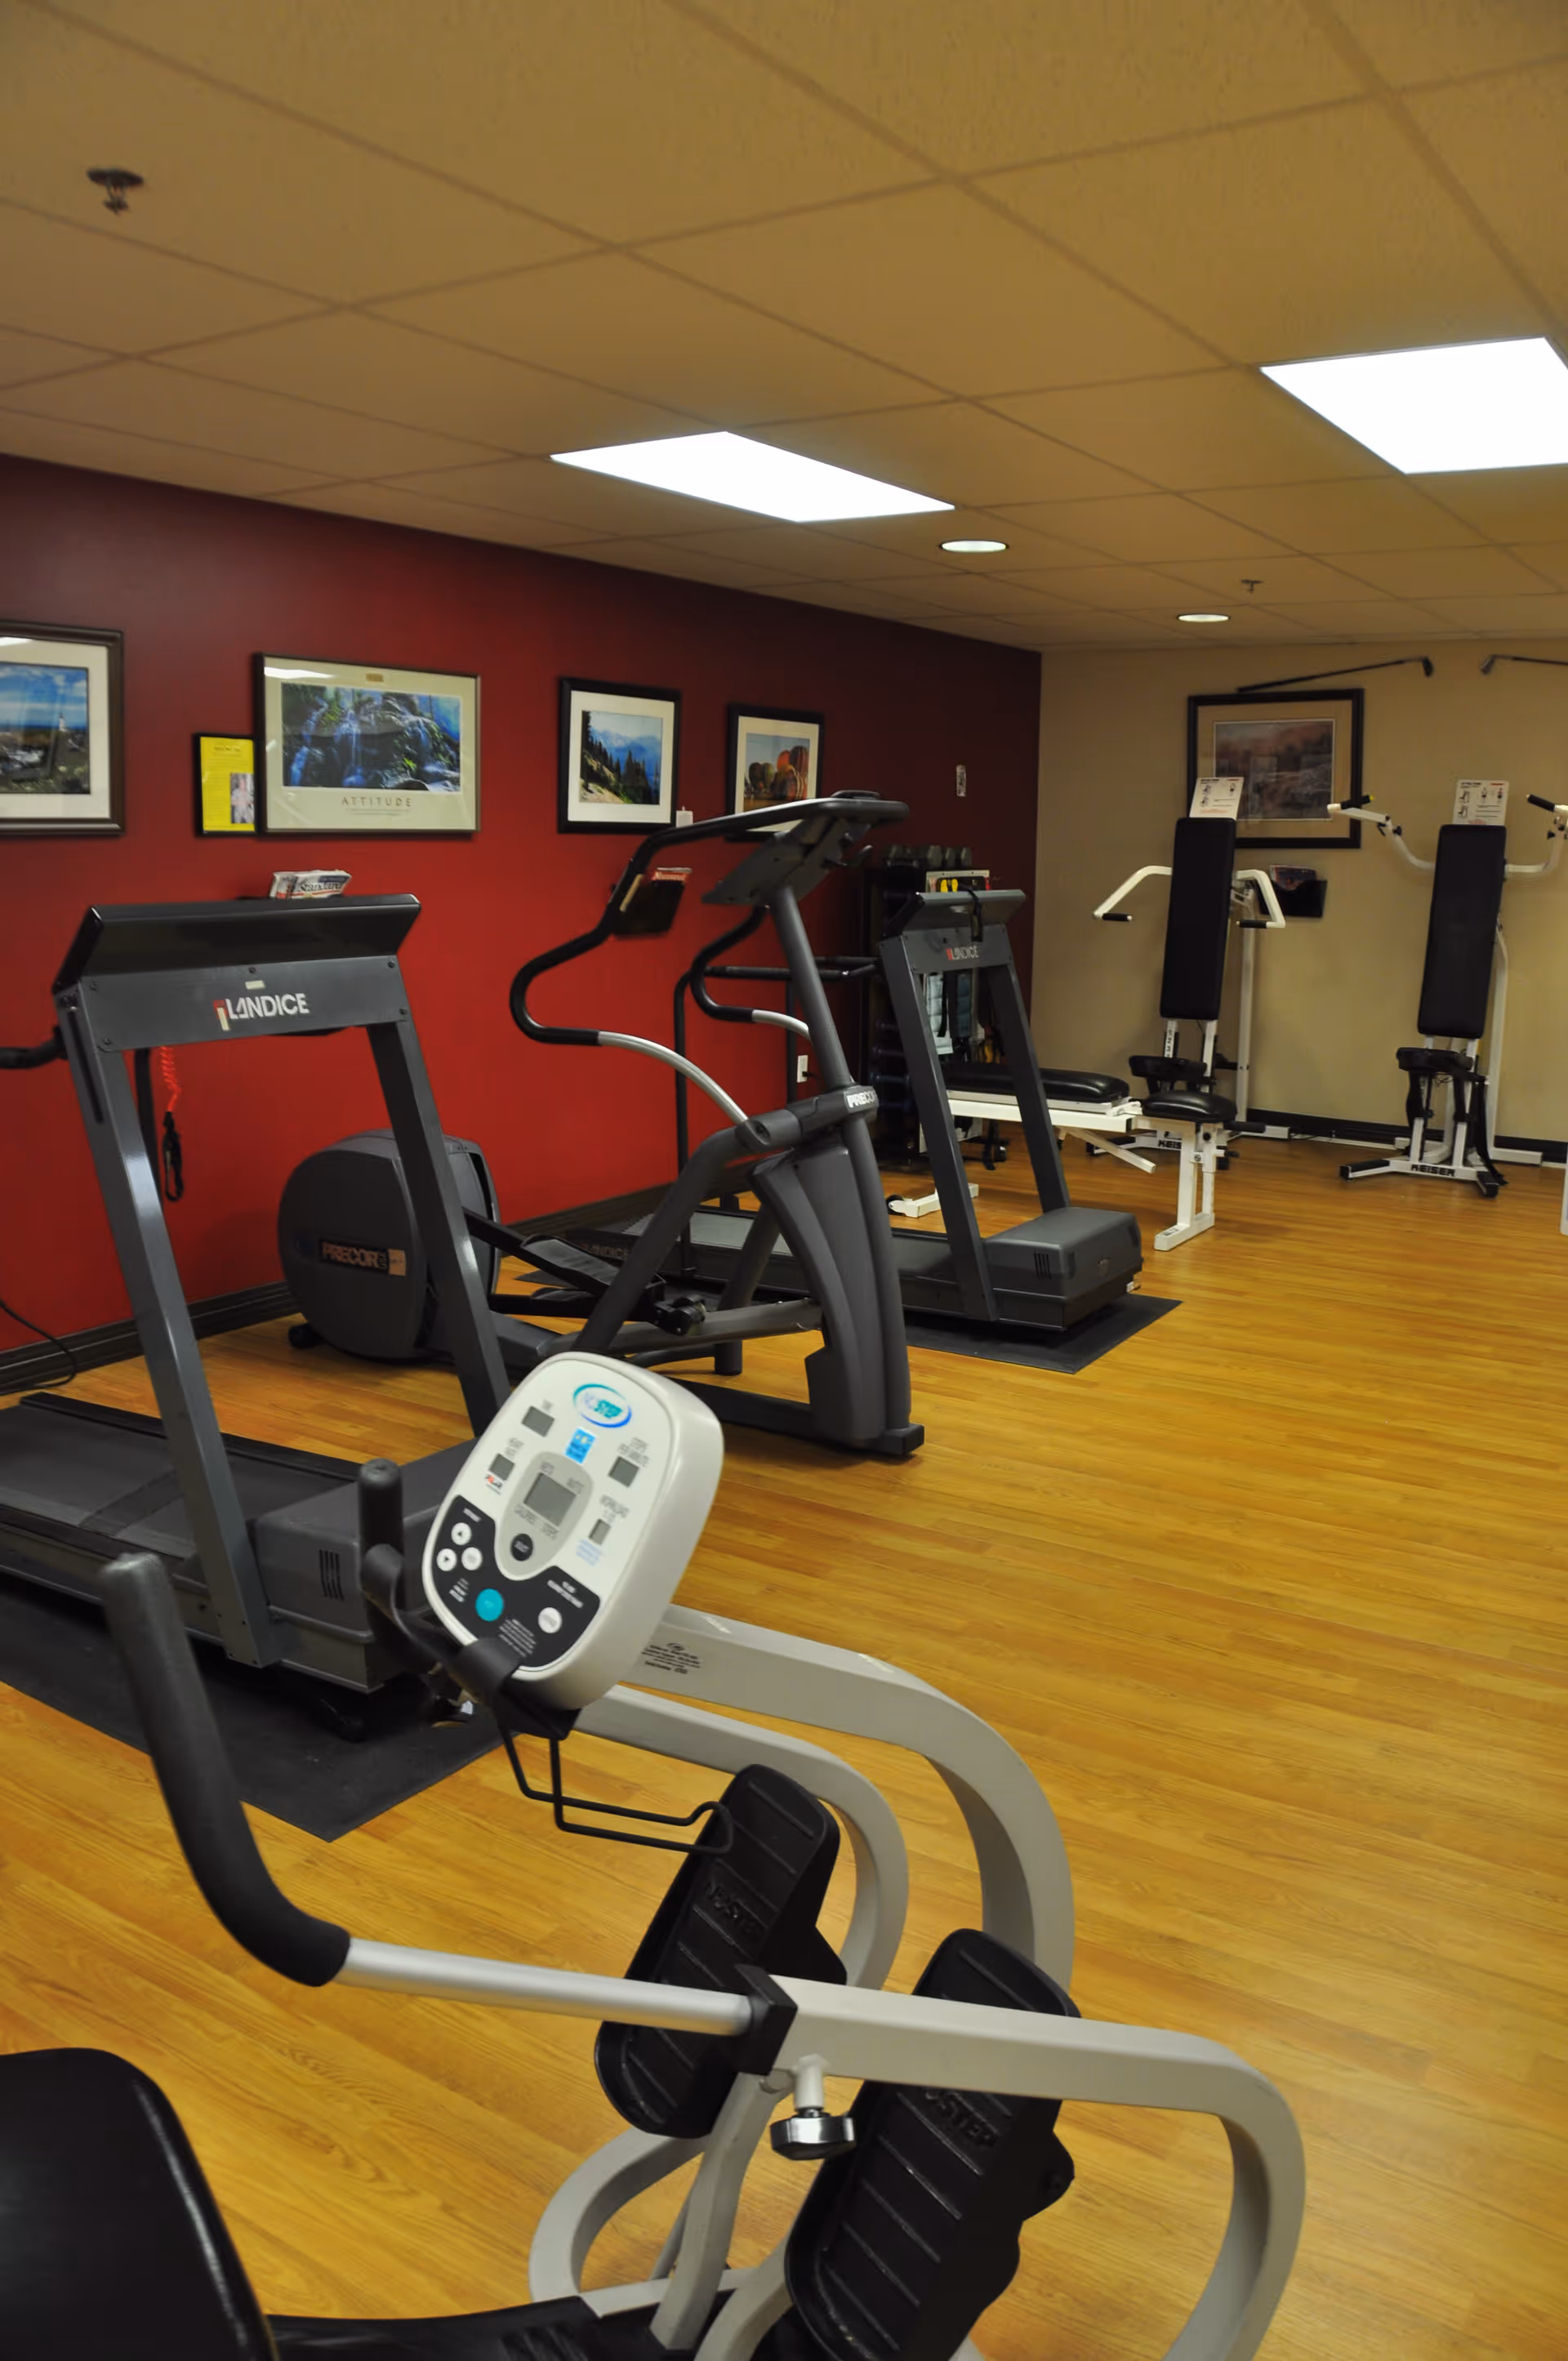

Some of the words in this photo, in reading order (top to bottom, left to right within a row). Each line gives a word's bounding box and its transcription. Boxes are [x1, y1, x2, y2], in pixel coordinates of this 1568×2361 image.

[341, 795, 412, 808] ATTITUDE
[225, 992, 310, 1020] LANDICE
[846, 1090, 876, 1108] PRECO
[1157, 1138, 1182, 1150] KEIS
[1410, 1164, 1456, 1178] KEISER
[322, 1241, 379, 1268] PRECOR
